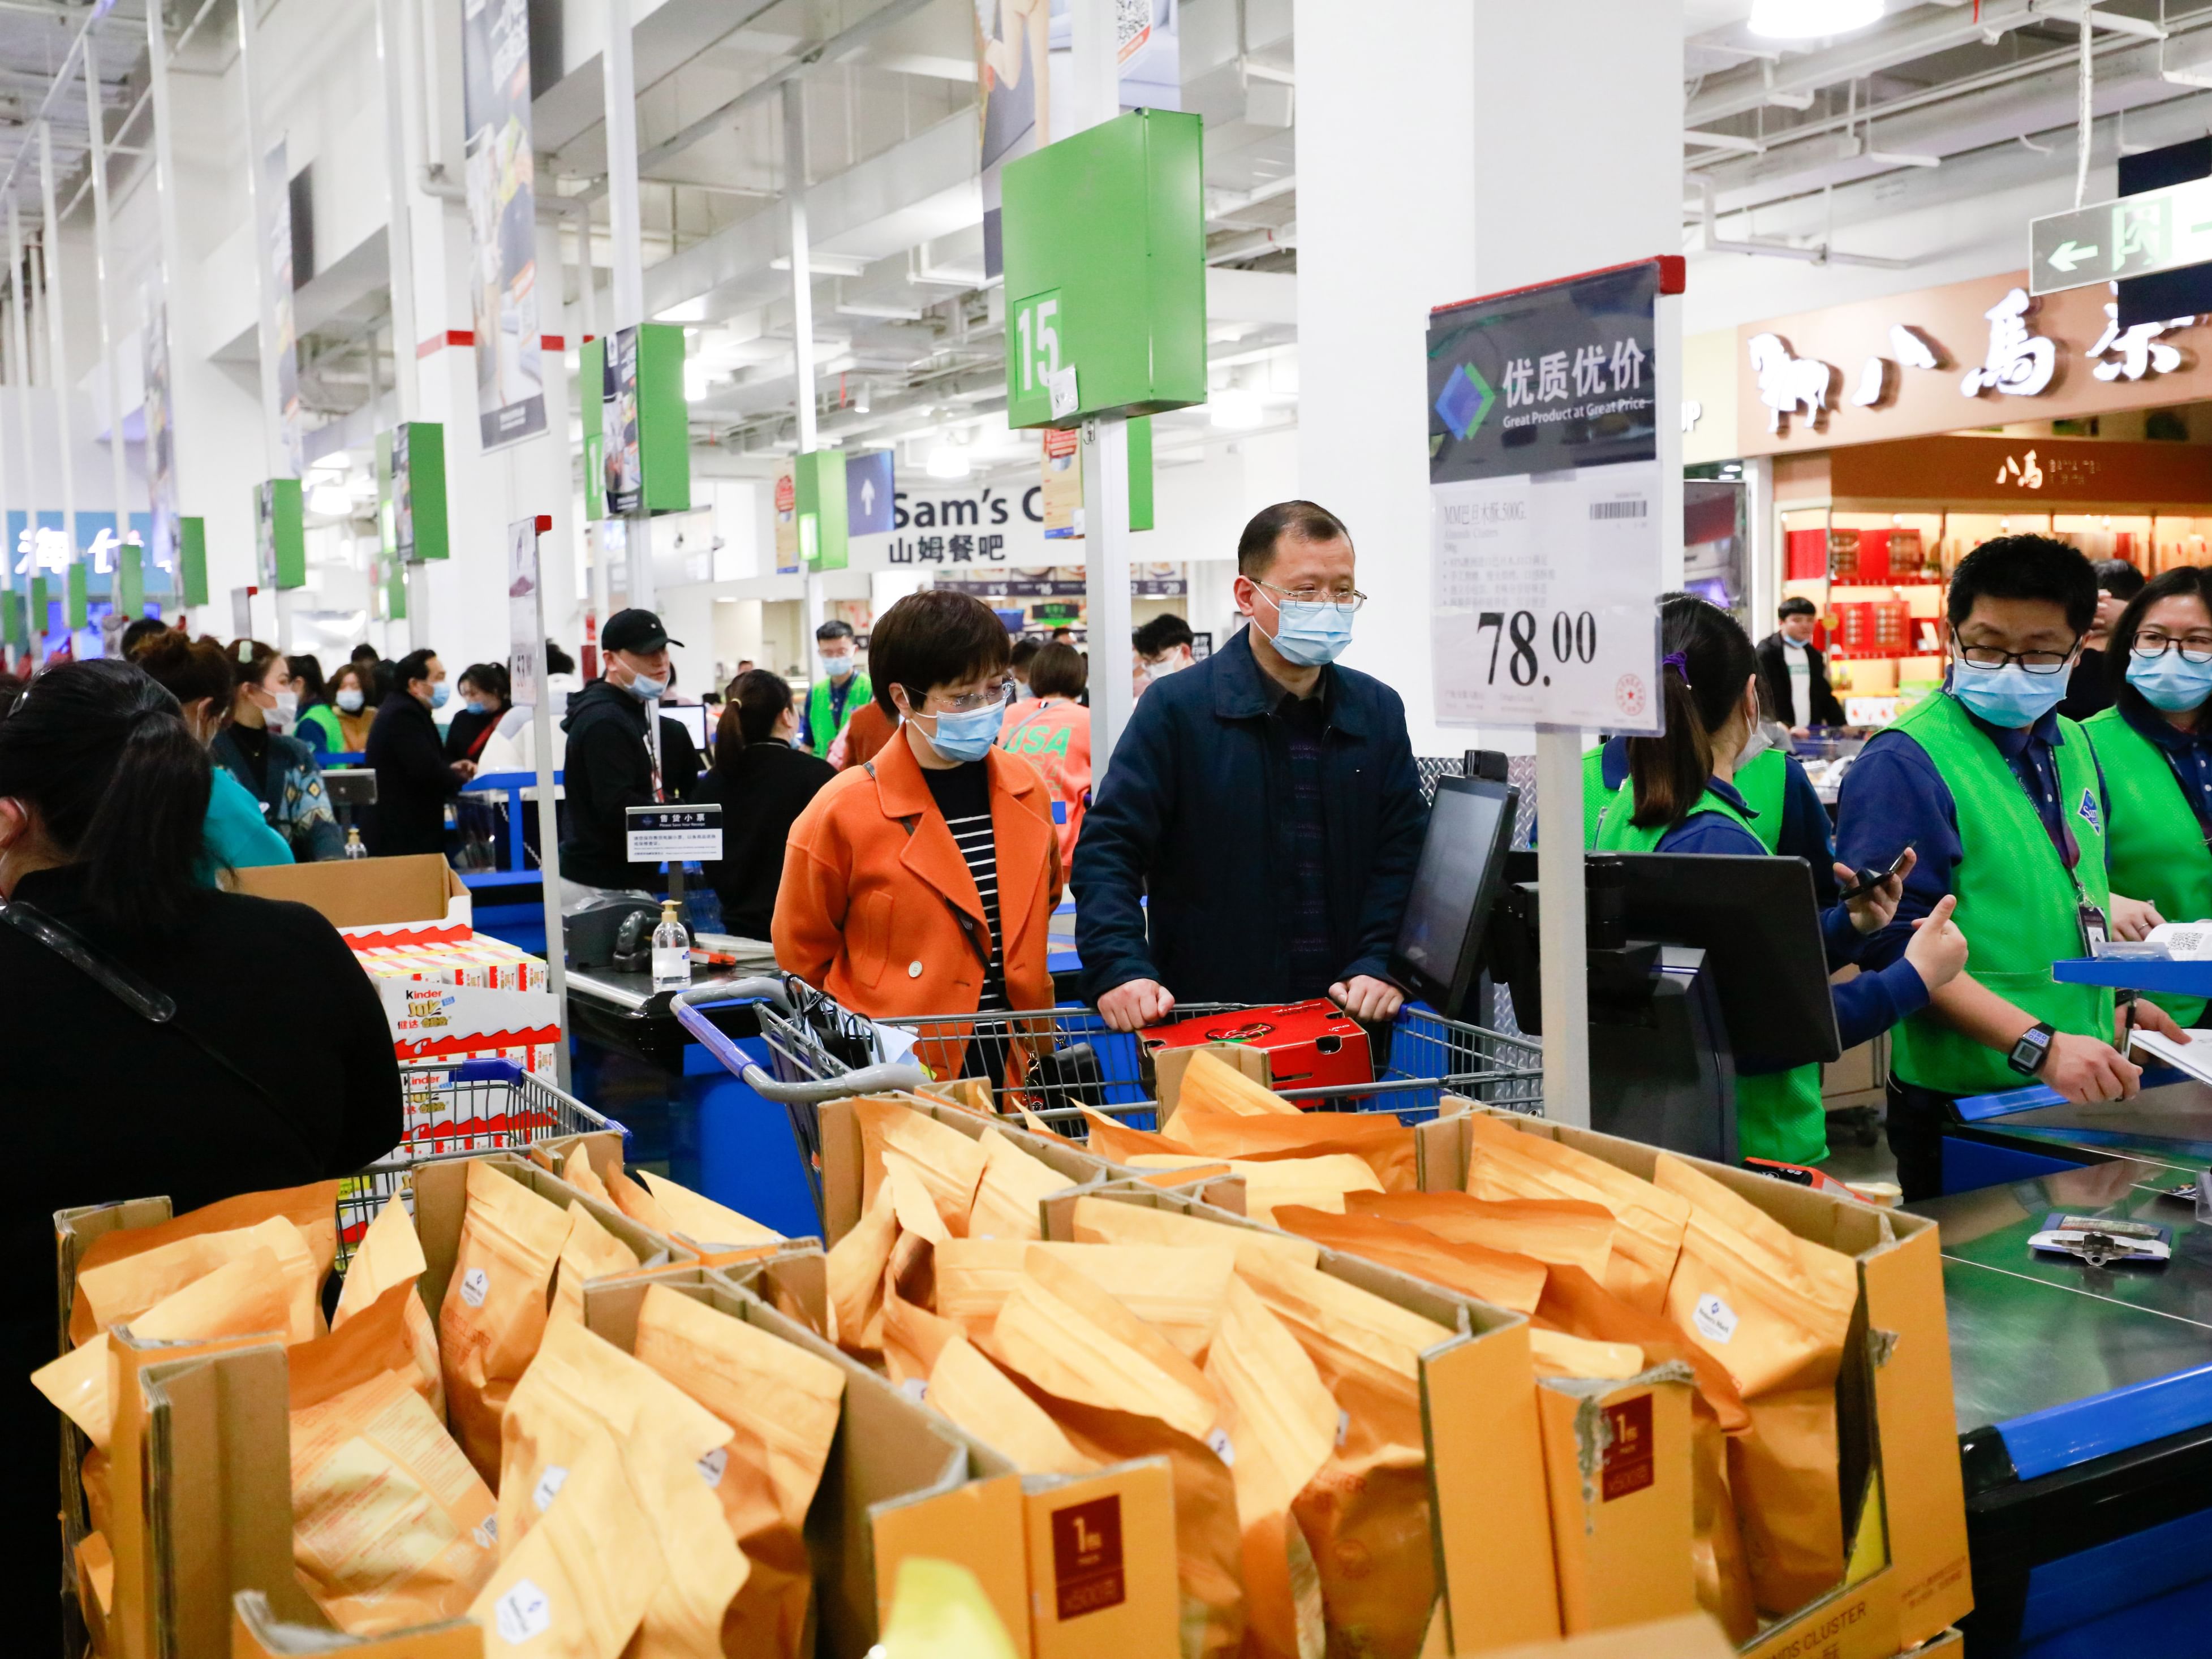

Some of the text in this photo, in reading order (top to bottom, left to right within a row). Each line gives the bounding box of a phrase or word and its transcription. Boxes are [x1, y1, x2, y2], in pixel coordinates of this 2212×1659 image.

[1018, 299, 1059, 391] 15
[1503, 338, 1645, 408] 优质优价
[1503, 397, 1645, 428] Great Product at Great Price
[894, 488, 1009, 529] Sam's
[889, 535, 1006, 564] 山姆餐吧
[1477, 610, 1596, 687] 78.00
[1005, 725, 1071, 757] USA
[660, 813, 705, 823] 售货小票
[1803, 1601, 1867, 1651] CLUSTER
